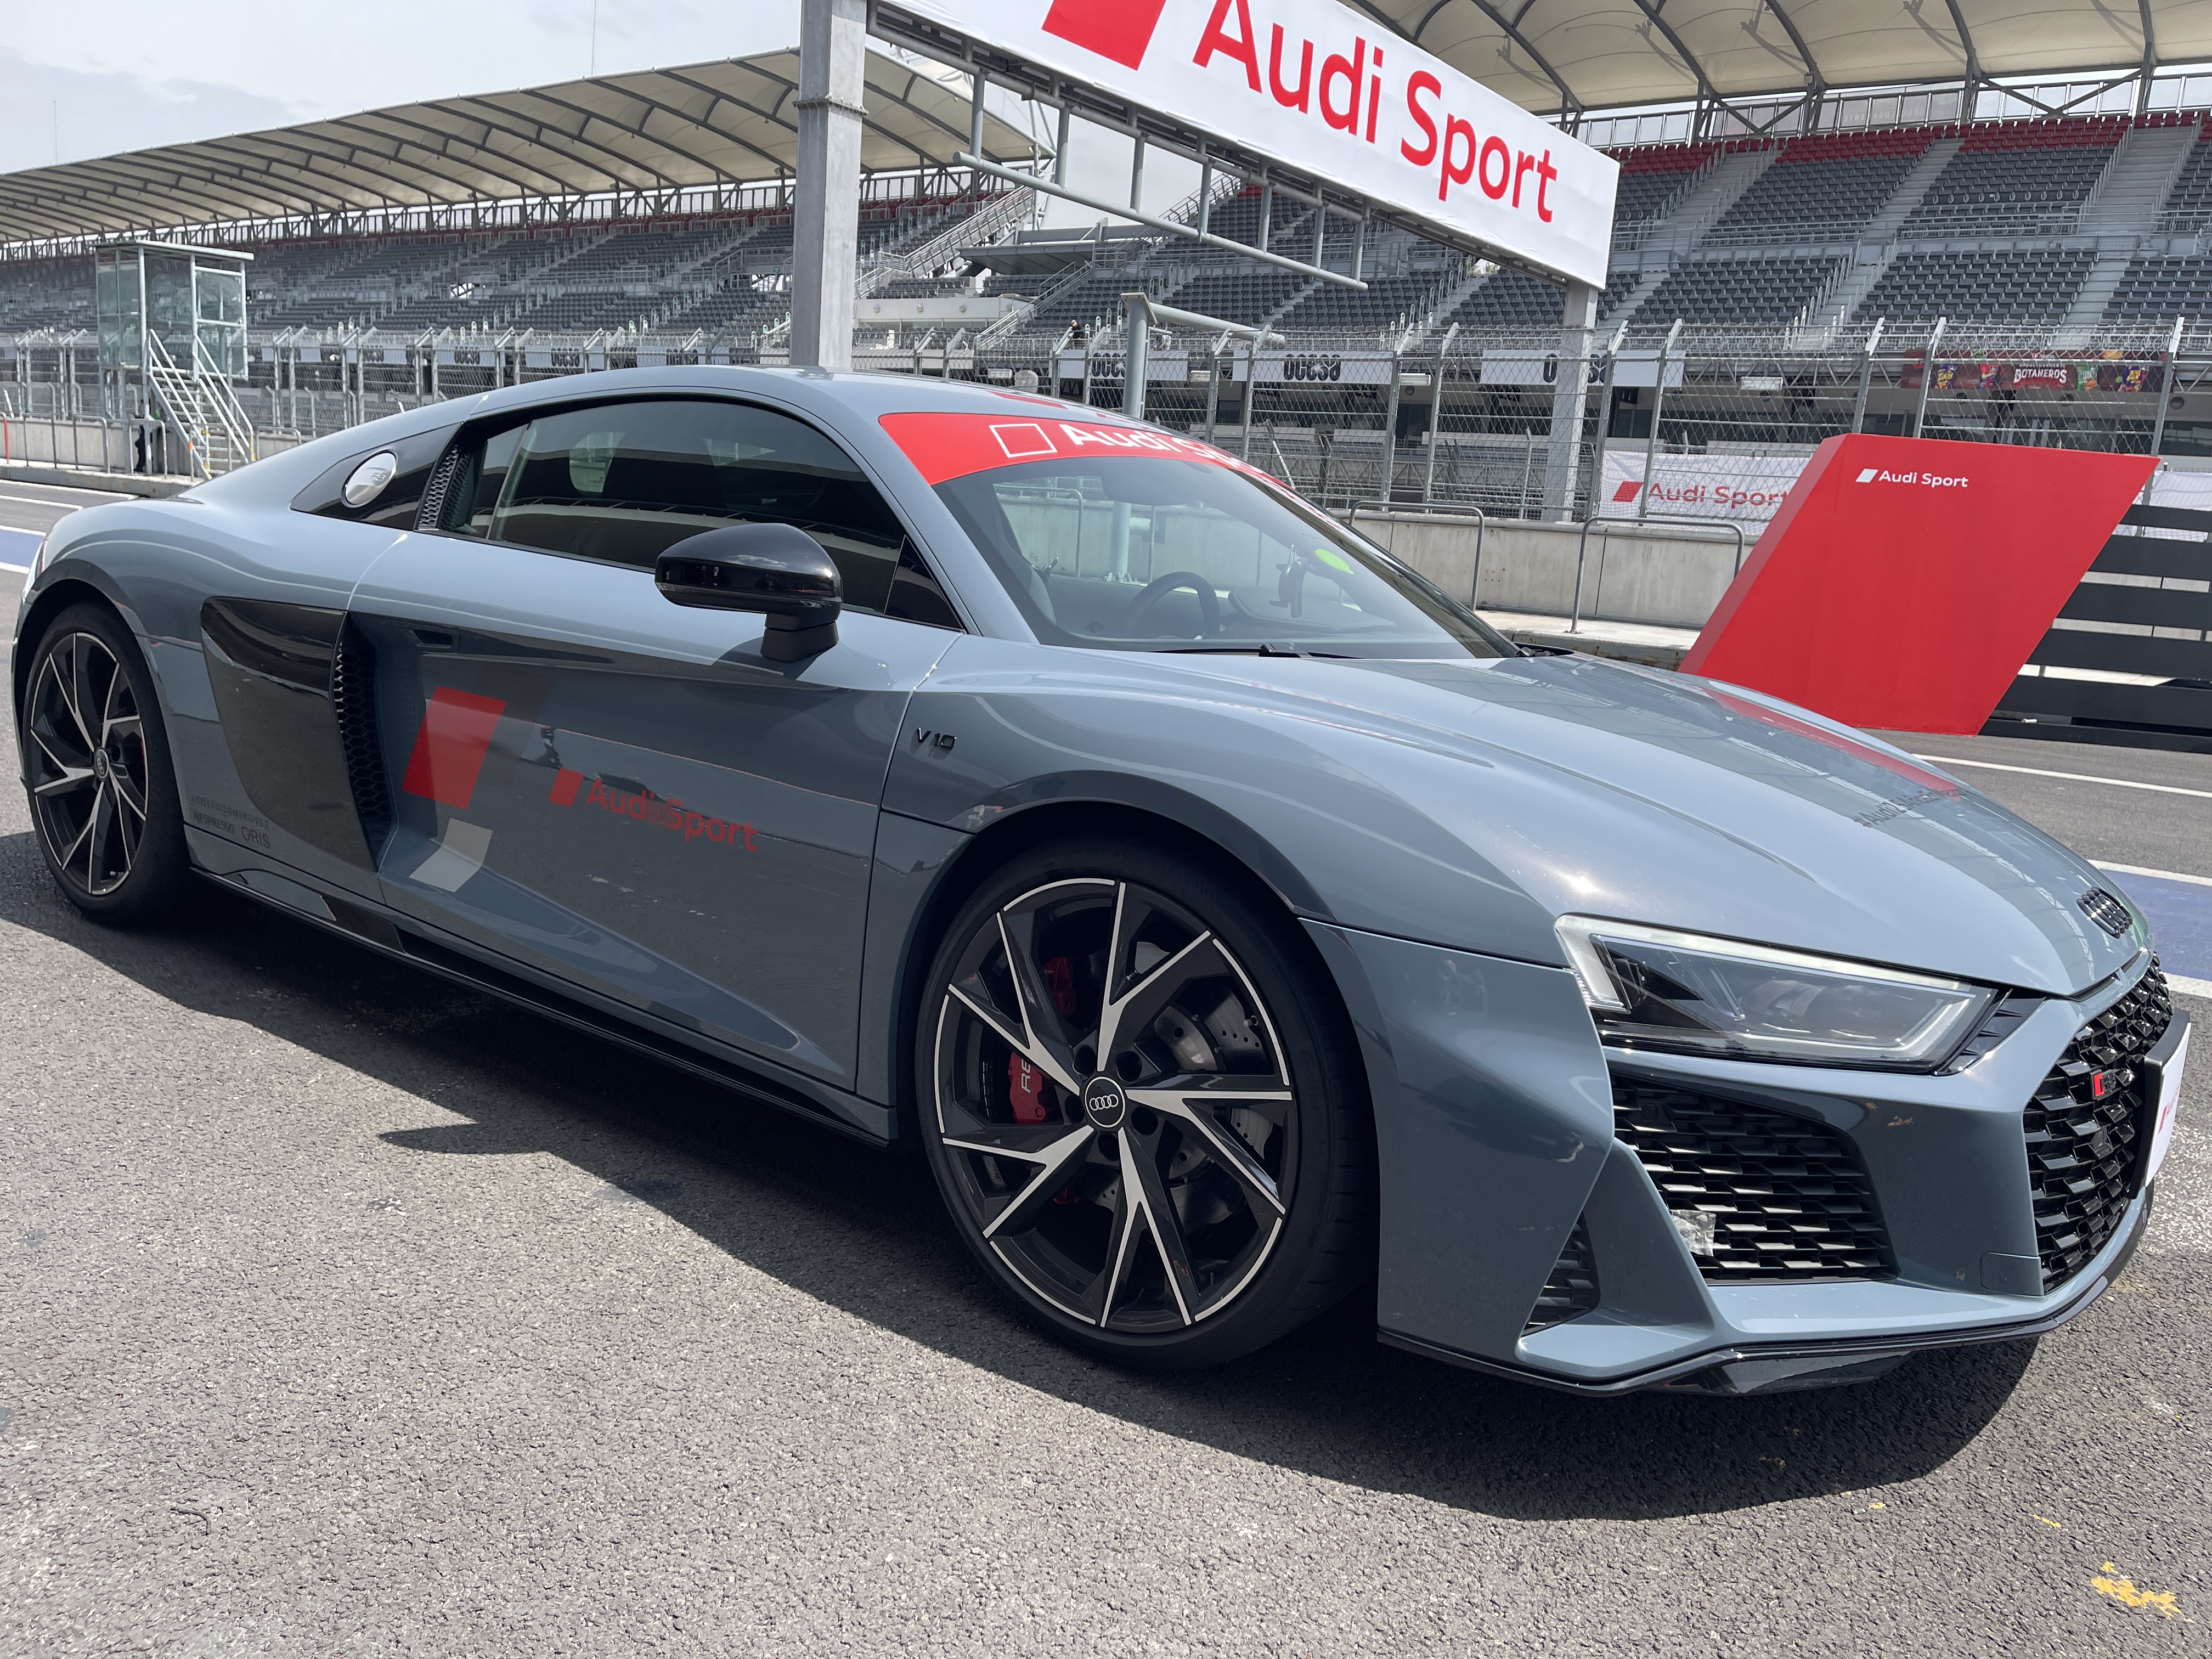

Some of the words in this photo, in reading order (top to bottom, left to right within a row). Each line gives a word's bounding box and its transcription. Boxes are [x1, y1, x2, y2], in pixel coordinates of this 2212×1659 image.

[1193, 0, 1384, 144] Audi
[1401, 70, 1558, 223] Sport
[2013, 368, 2067, 384] BOTANEROS
[1059, 424, 1183, 453] Audi
[1878, 470, 1918, 483] Audi
[1921, 473, 1968, 488] Sport
[1648, 483, 1706, 503] Audi
[917, 727, 957, 750] V10
[586, 778, 655, 824] Audi
[665, 798, 758, 852] Sport
[241, 826, 270, 849] ORIS
